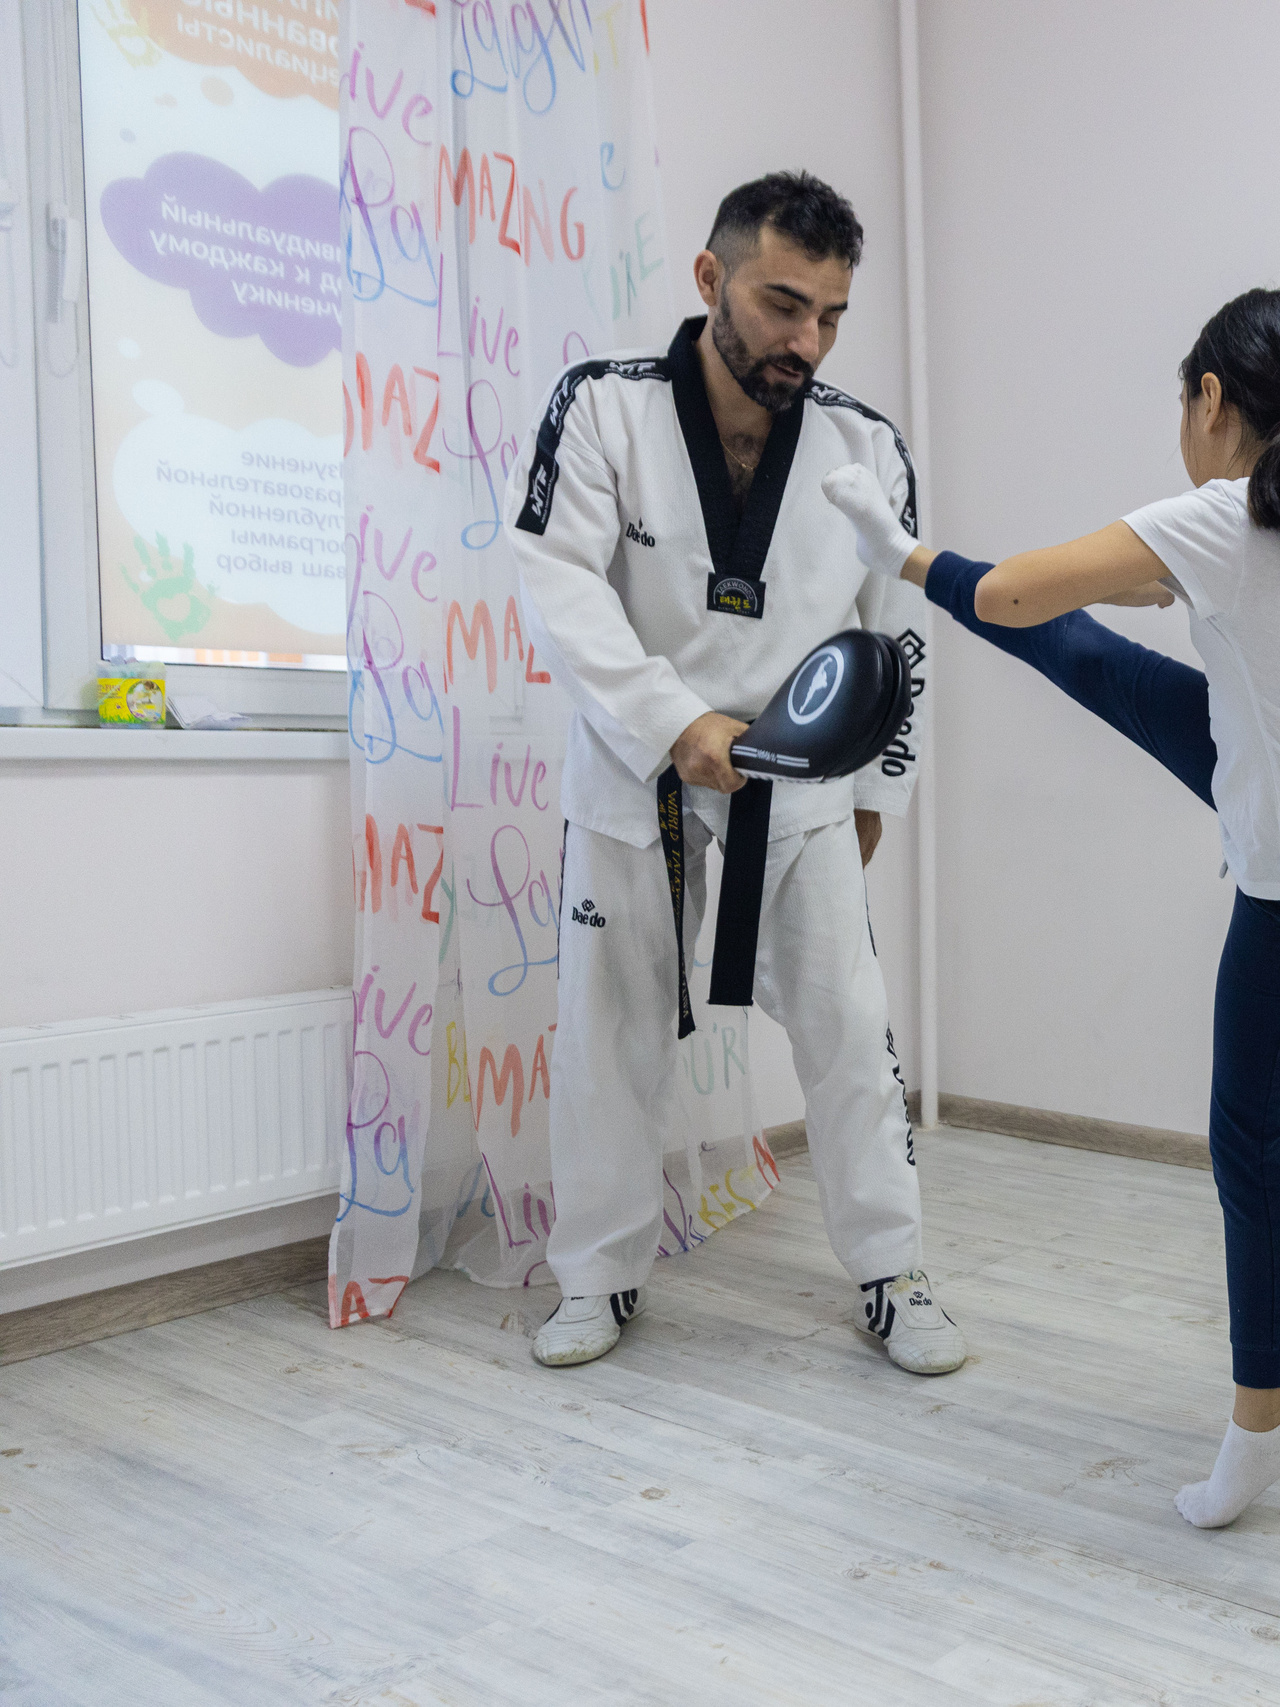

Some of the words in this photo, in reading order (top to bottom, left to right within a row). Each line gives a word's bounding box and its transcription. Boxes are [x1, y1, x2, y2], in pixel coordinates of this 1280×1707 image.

[437, 252, 521, 377] Live
[451, 705, 549, 812] Live
[667, 790, 680, 841] WORLD
